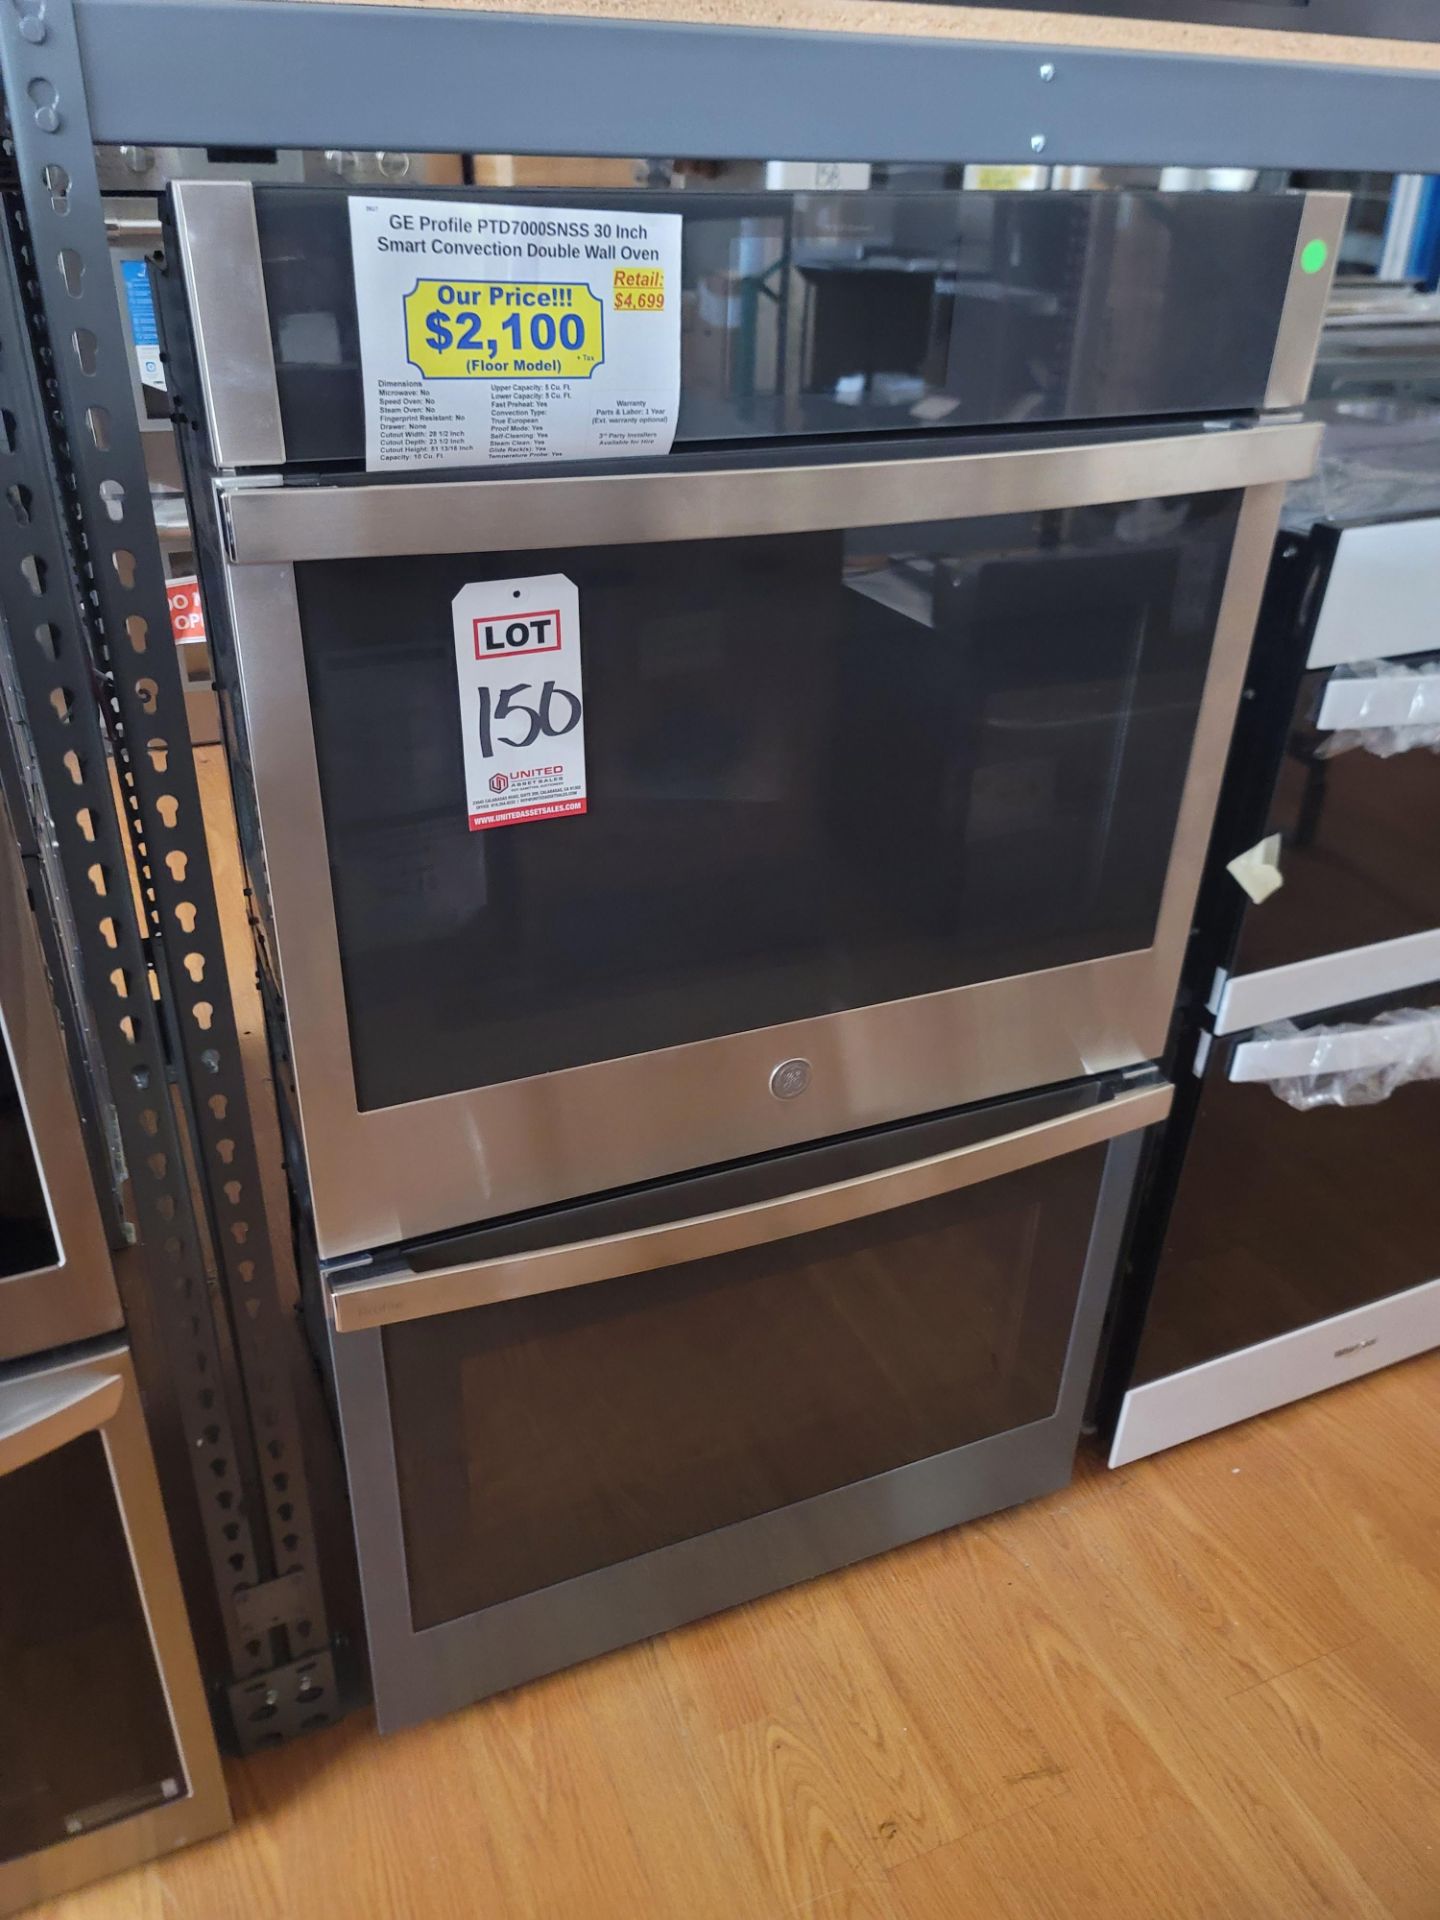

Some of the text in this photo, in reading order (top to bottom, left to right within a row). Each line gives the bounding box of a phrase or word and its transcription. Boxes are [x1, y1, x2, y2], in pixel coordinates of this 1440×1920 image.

[389, 214, 648, 240] GE Profile PTD7000SNSS 30 Inch
[377, 236, 660, 261] Smart Convection Double Wall Oven
[613, 269, 664, 287] Retail:
[437, 284, 573, 307] Our Price!!!
[613, 292, 665, 310] $4,699
[425, 309, 586, 359] $2,100
[465, 359, 562, 374] (Floor Model)
[378, 380, 423, 388] Dimensions
[490, 384, 511, 393] Upper
[379, 398, 401, 406] Speed
[513, 393, 543, 401] Capacity:
[616, 400, 646, 408] Warranty
[380, 415, 418, 423] Fingerprint
[491, 409, 529, 417] Convection
[485, 619, 551, 651] LOT
[510, 765, 563, 779] UNITED
[474, 802, 581, 825] WWW.UNITEDASSETSALES.COM
